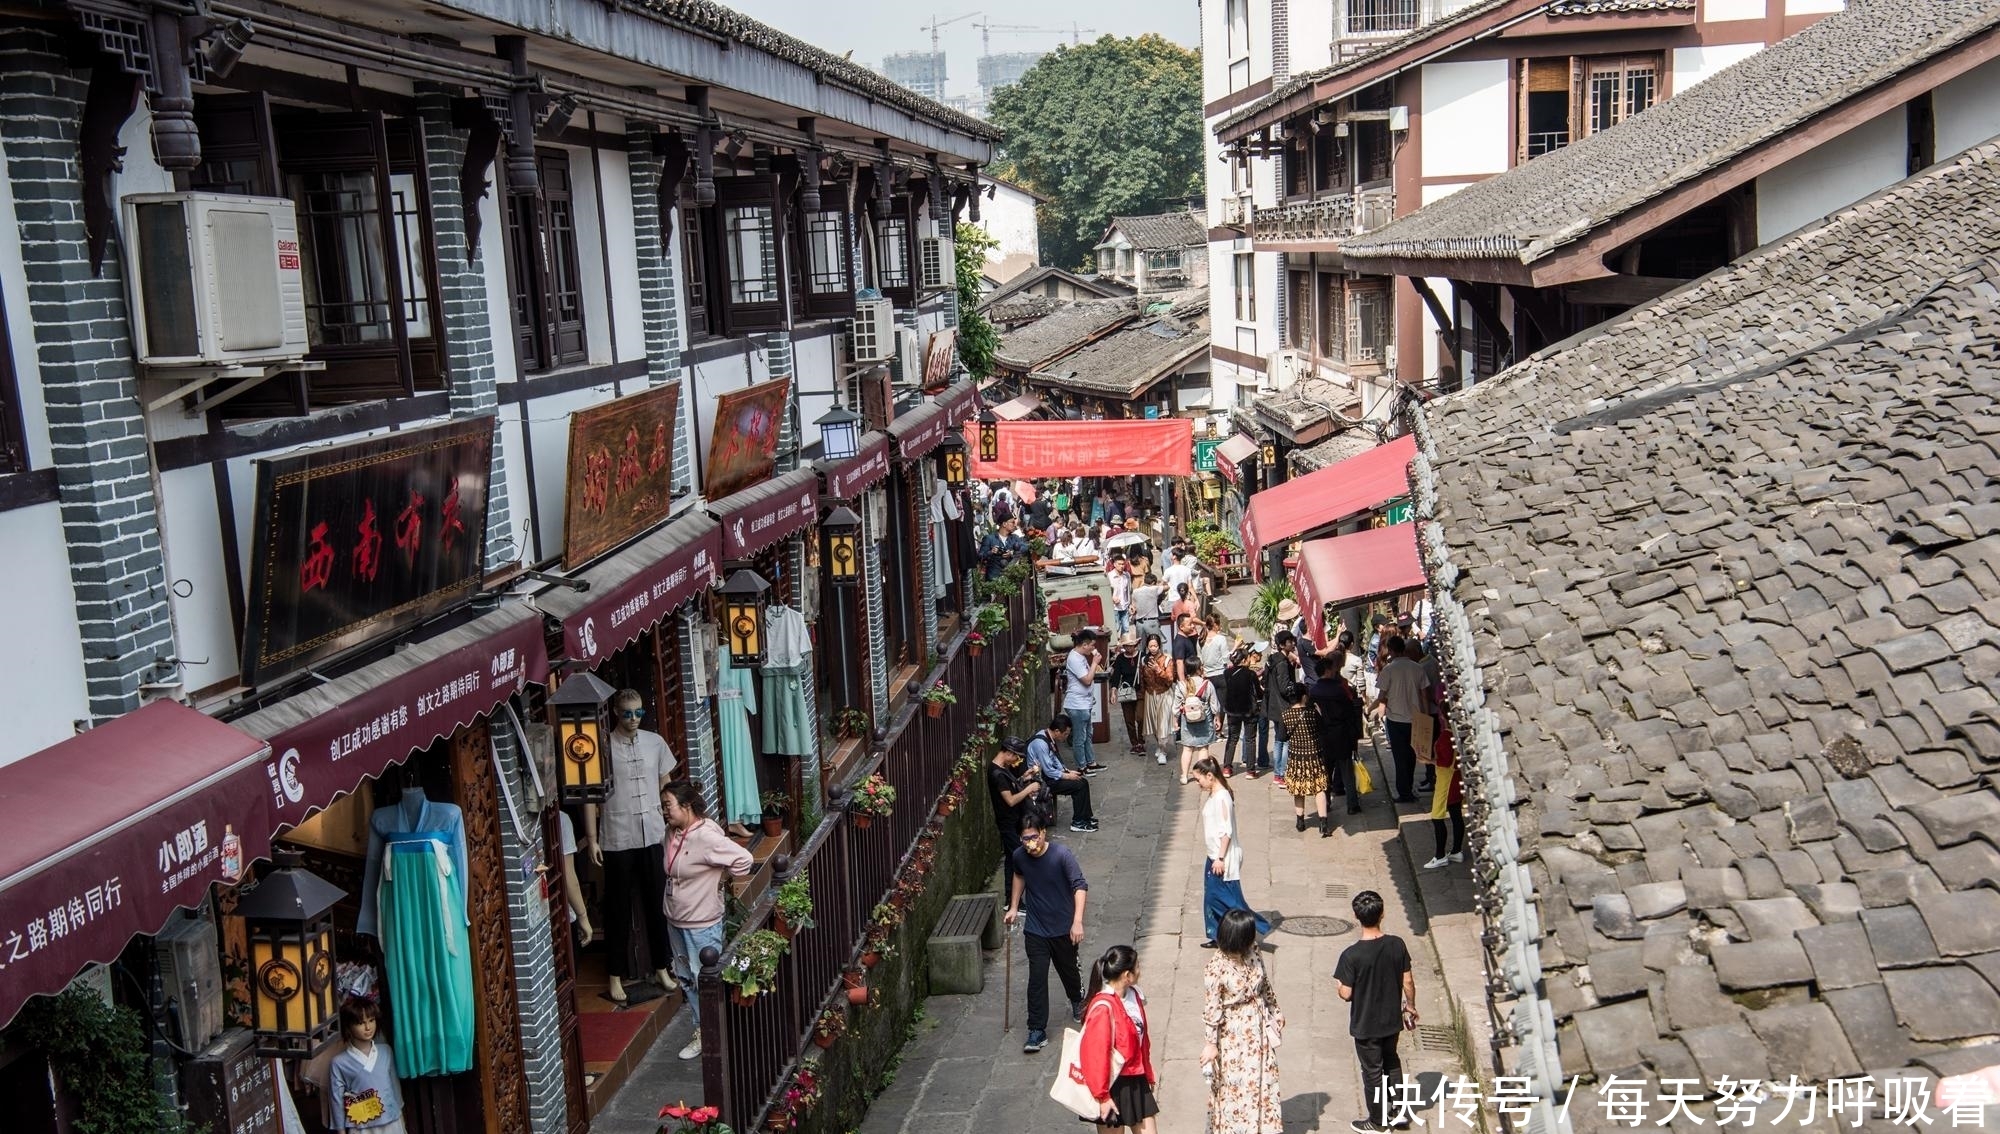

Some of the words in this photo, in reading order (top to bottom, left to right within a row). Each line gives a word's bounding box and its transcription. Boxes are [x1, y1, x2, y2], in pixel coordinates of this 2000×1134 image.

[330, 705, 409, 762] 创卫成功感谢有您
[417, 670, 480, 717] 创文之路期待同行
[159, 819, 208, 873] 小郎酒
[0, 876, 122, 969] 之路期待同行
